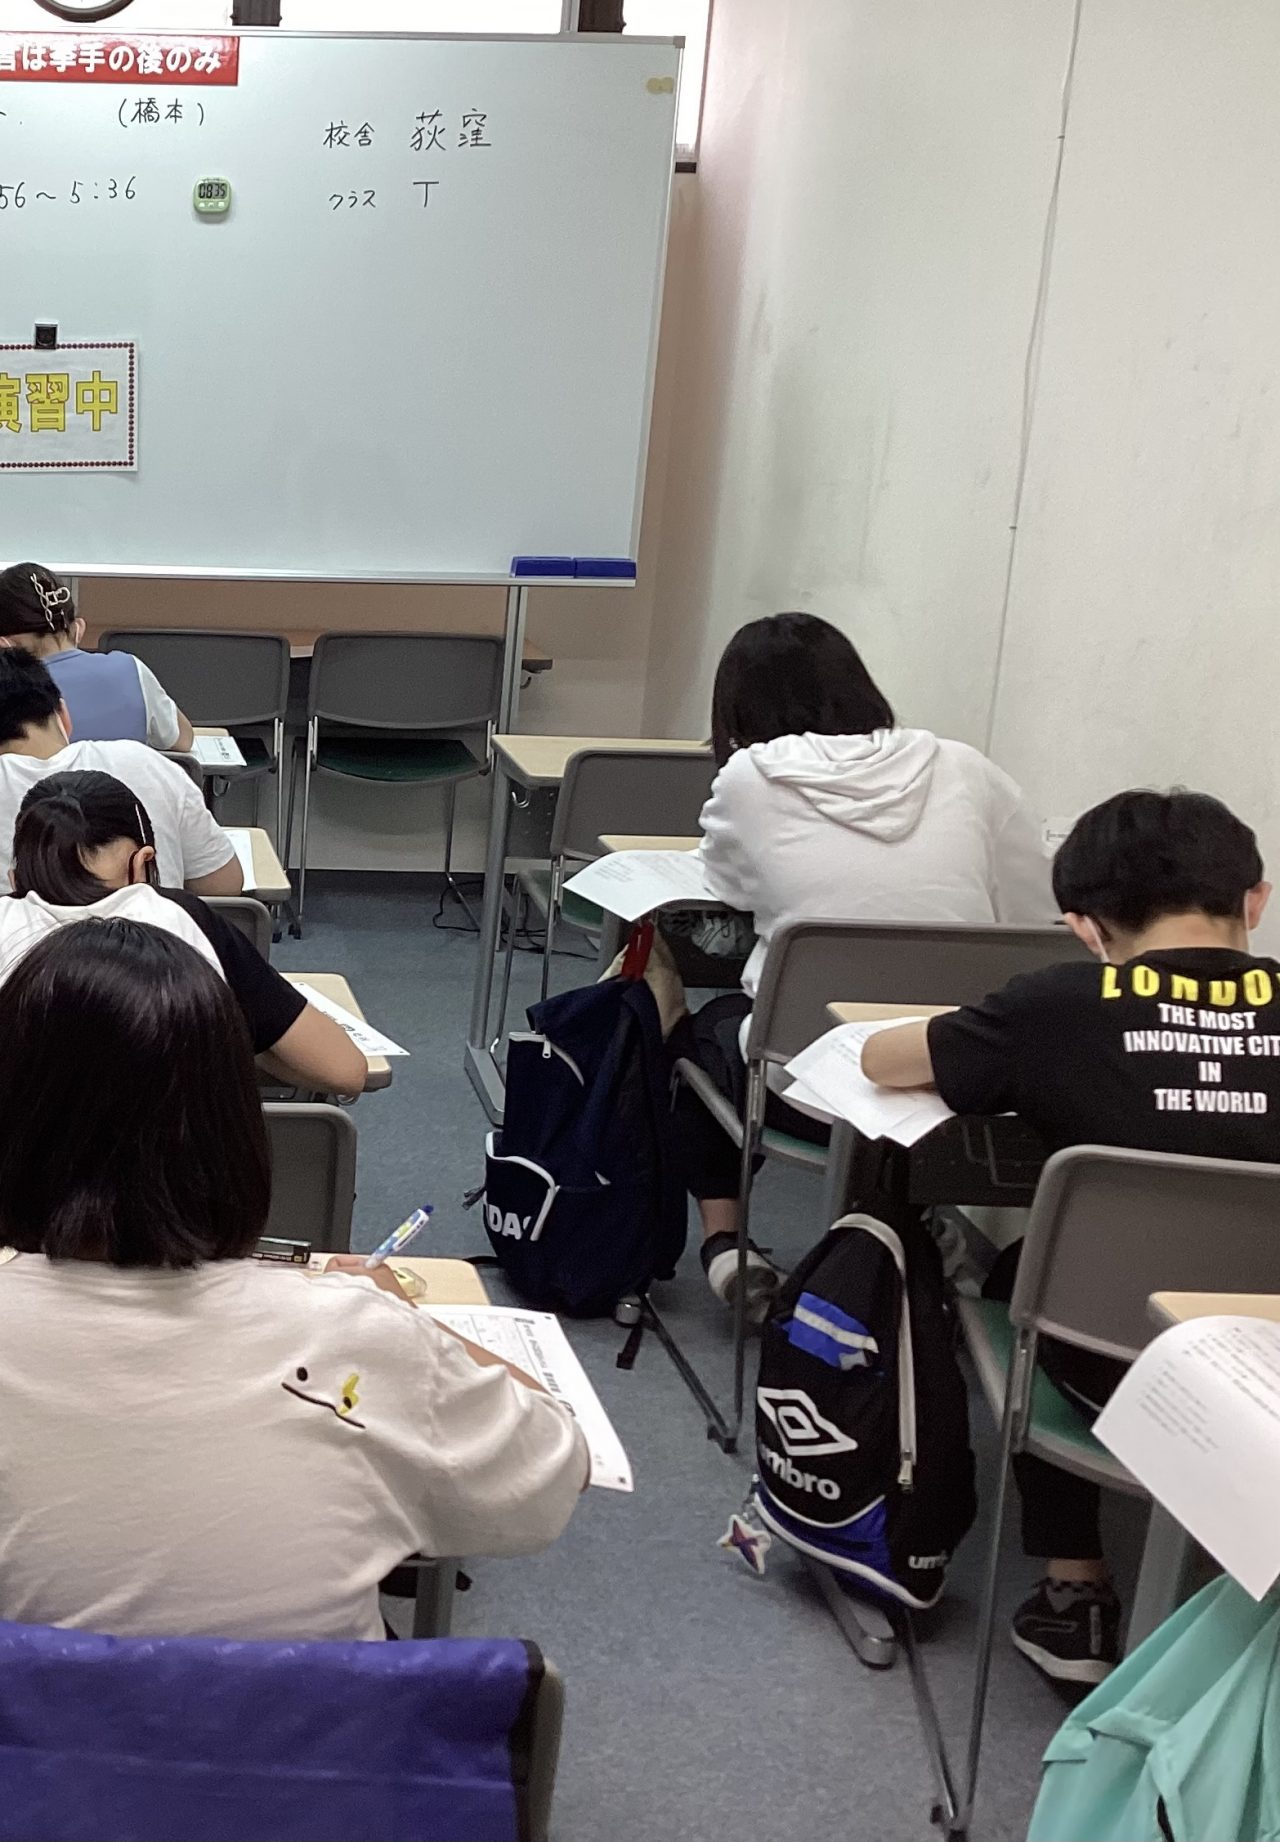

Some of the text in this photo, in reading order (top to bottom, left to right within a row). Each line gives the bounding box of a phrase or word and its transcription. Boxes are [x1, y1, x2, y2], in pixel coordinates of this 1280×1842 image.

[322, 107, 492, 152] 校舎 荻窪
[328, 189, 377, 211] クラス
[1101, 964, 1280, 1007] LONDO
[1157, 1002, 1257, 1031] THE MOST
[1123, 1030, 1245, 1056] INNOVATIVE
[1198, 1061, 1222, 1083] IN
[1153, 1088, 1268, 1114] THE WORLD
